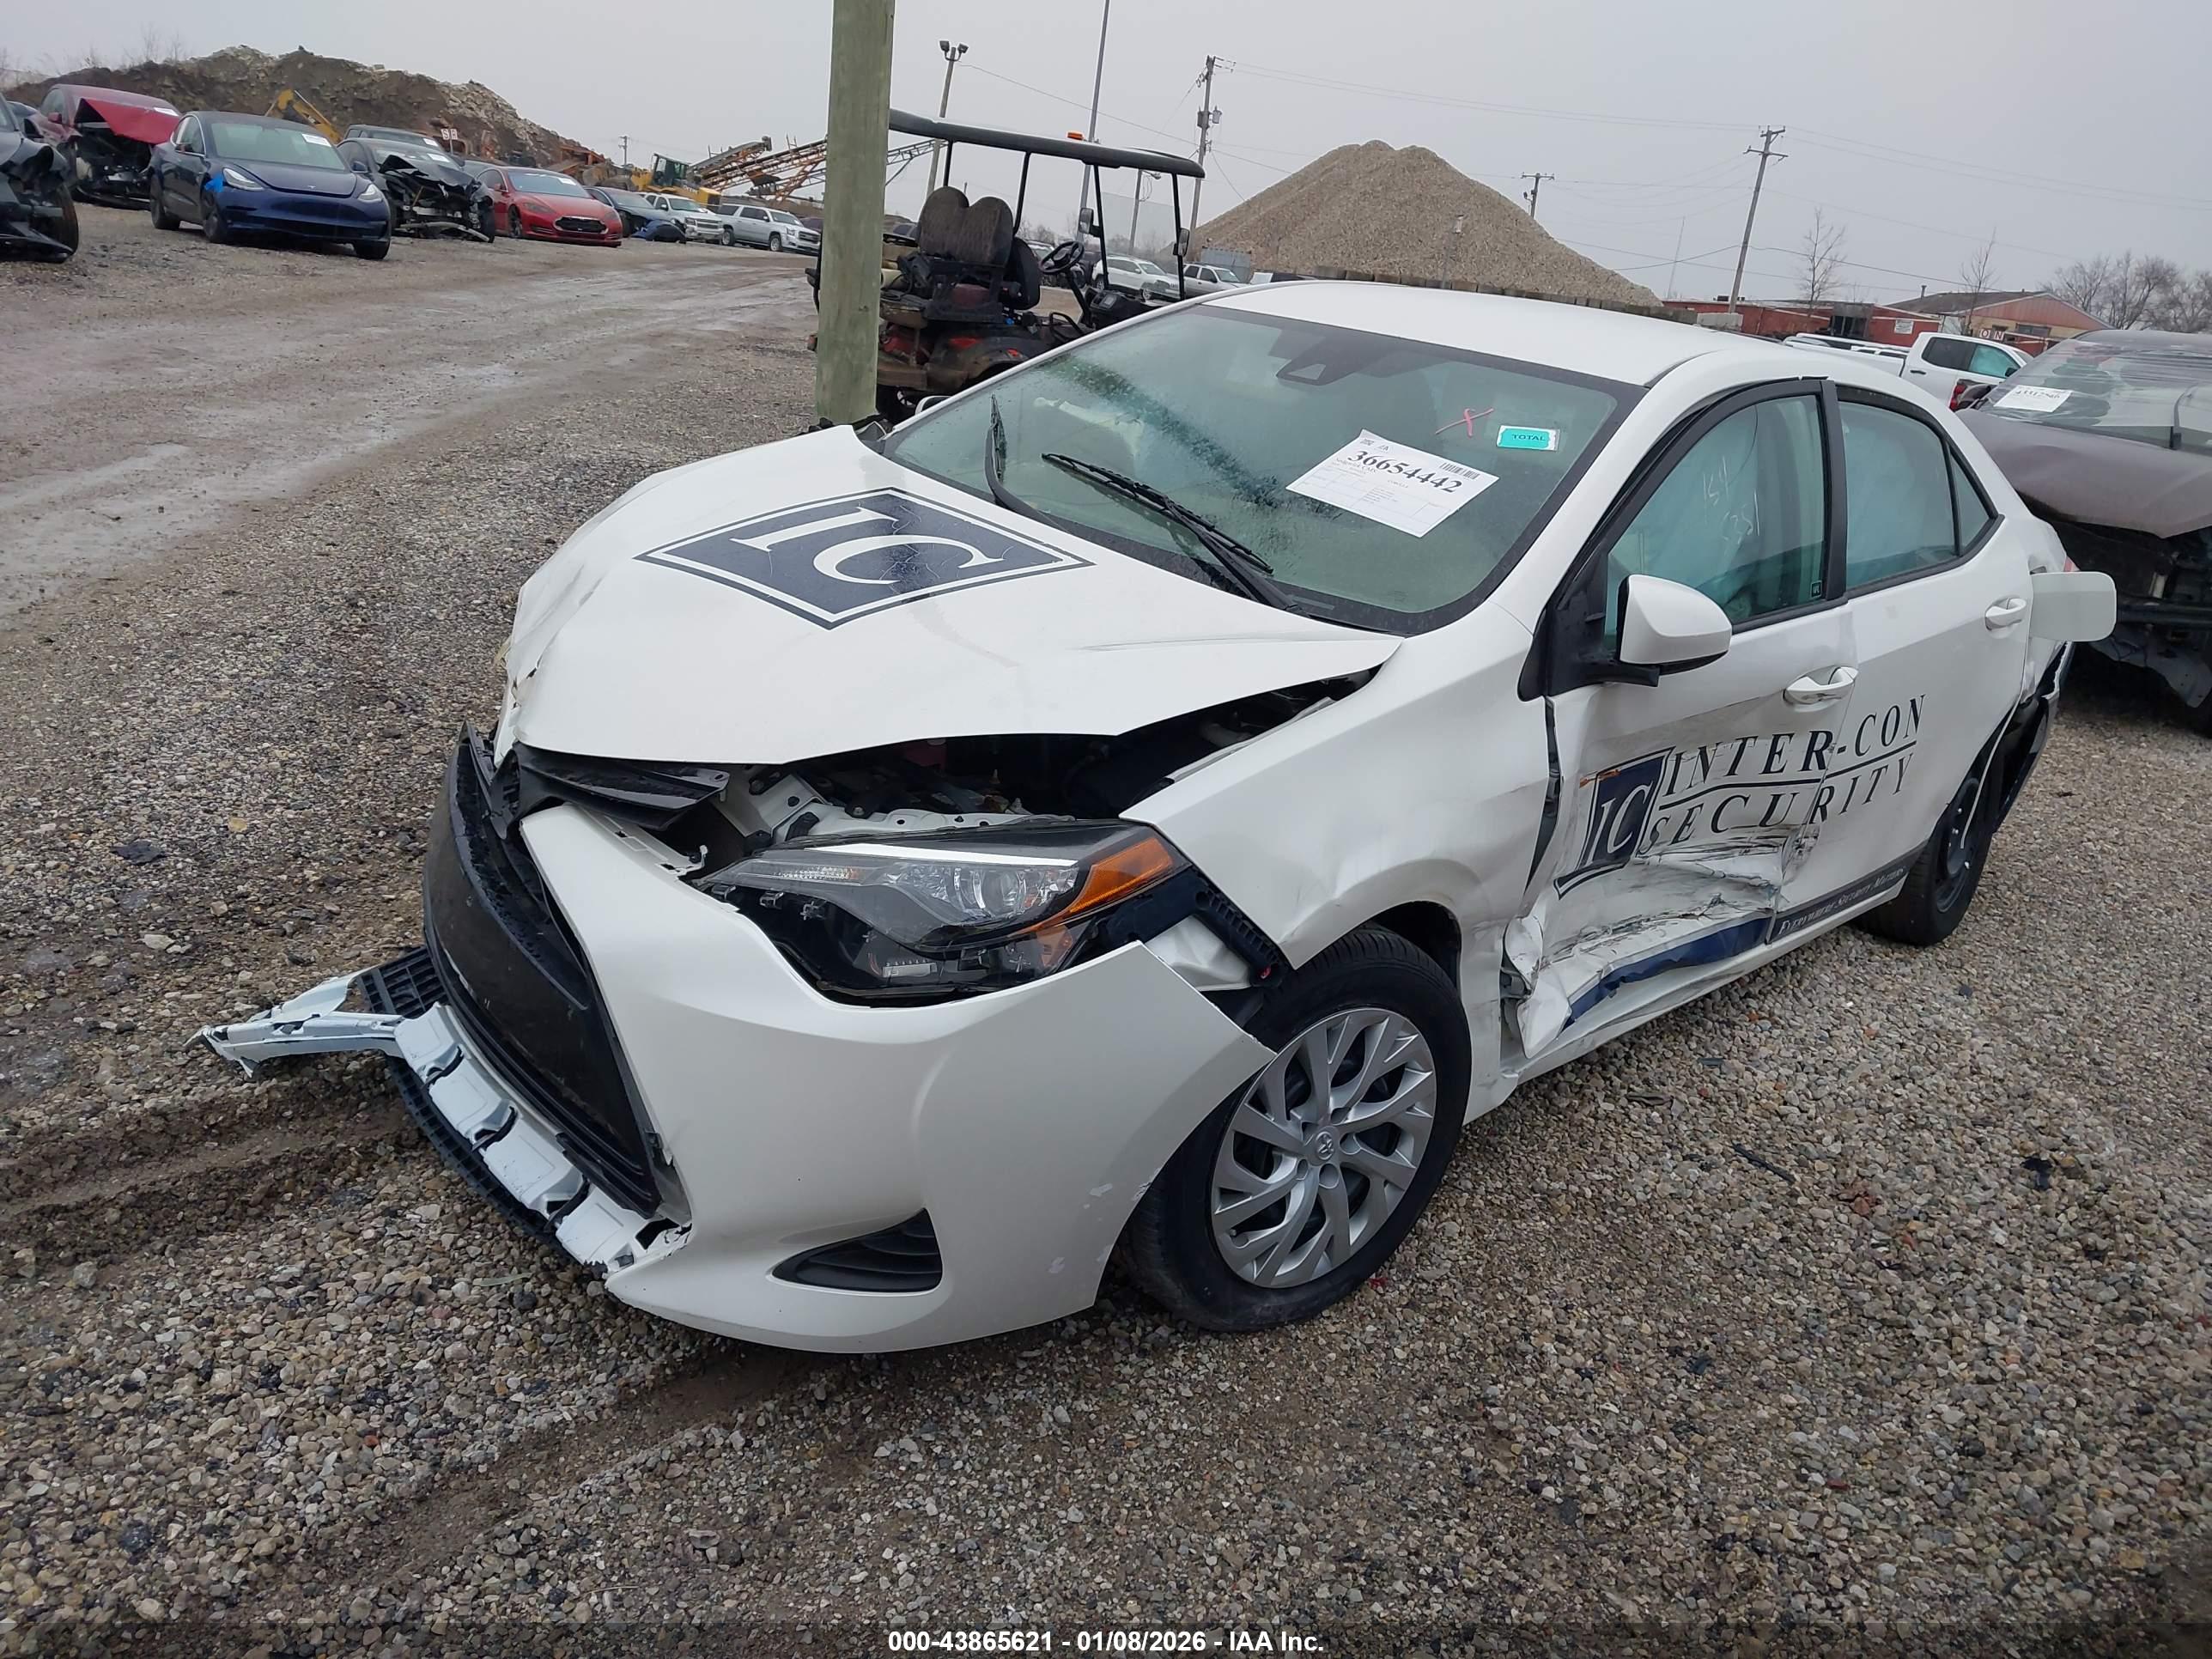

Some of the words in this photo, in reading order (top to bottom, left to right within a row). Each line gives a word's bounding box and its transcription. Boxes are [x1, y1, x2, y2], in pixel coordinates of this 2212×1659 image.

[1347, 451, 1462, 493] 36654442
[730, 506, 1006, 586] IC
[1663, 693, 1926, 797] INTER-CON
[1589, 782, 1653, 866] IC
[1638, 753, 1915, 854] SECURITY
